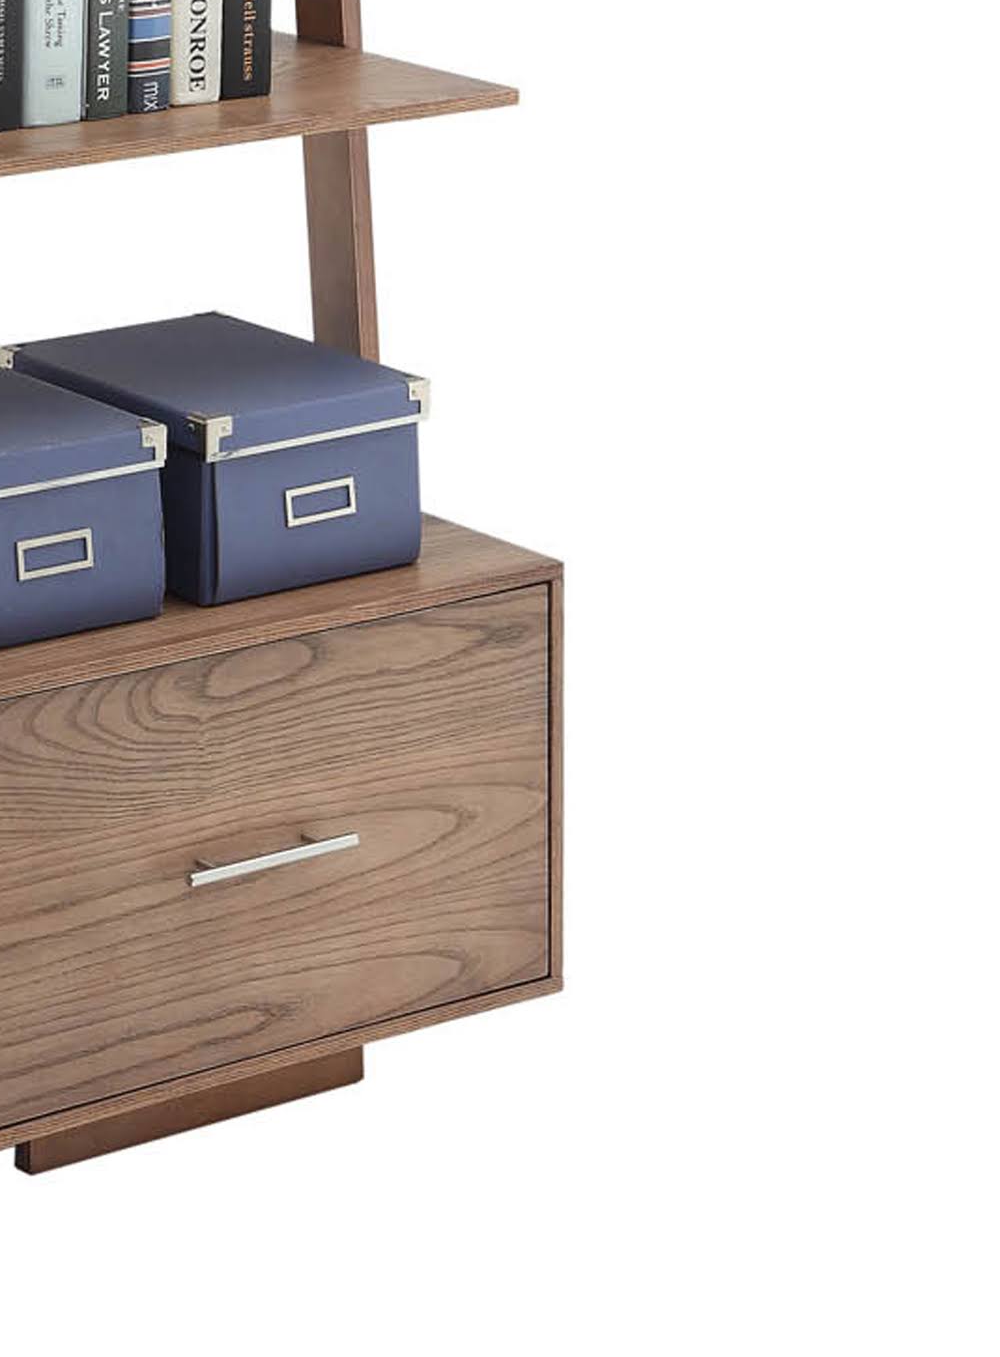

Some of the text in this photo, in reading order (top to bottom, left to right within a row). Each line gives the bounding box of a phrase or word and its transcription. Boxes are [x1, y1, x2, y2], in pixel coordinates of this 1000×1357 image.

[45, 0, 54, 15] the
[96, 10, 115, 101] LAWYER
[242, 23, 256, 81] strauss
